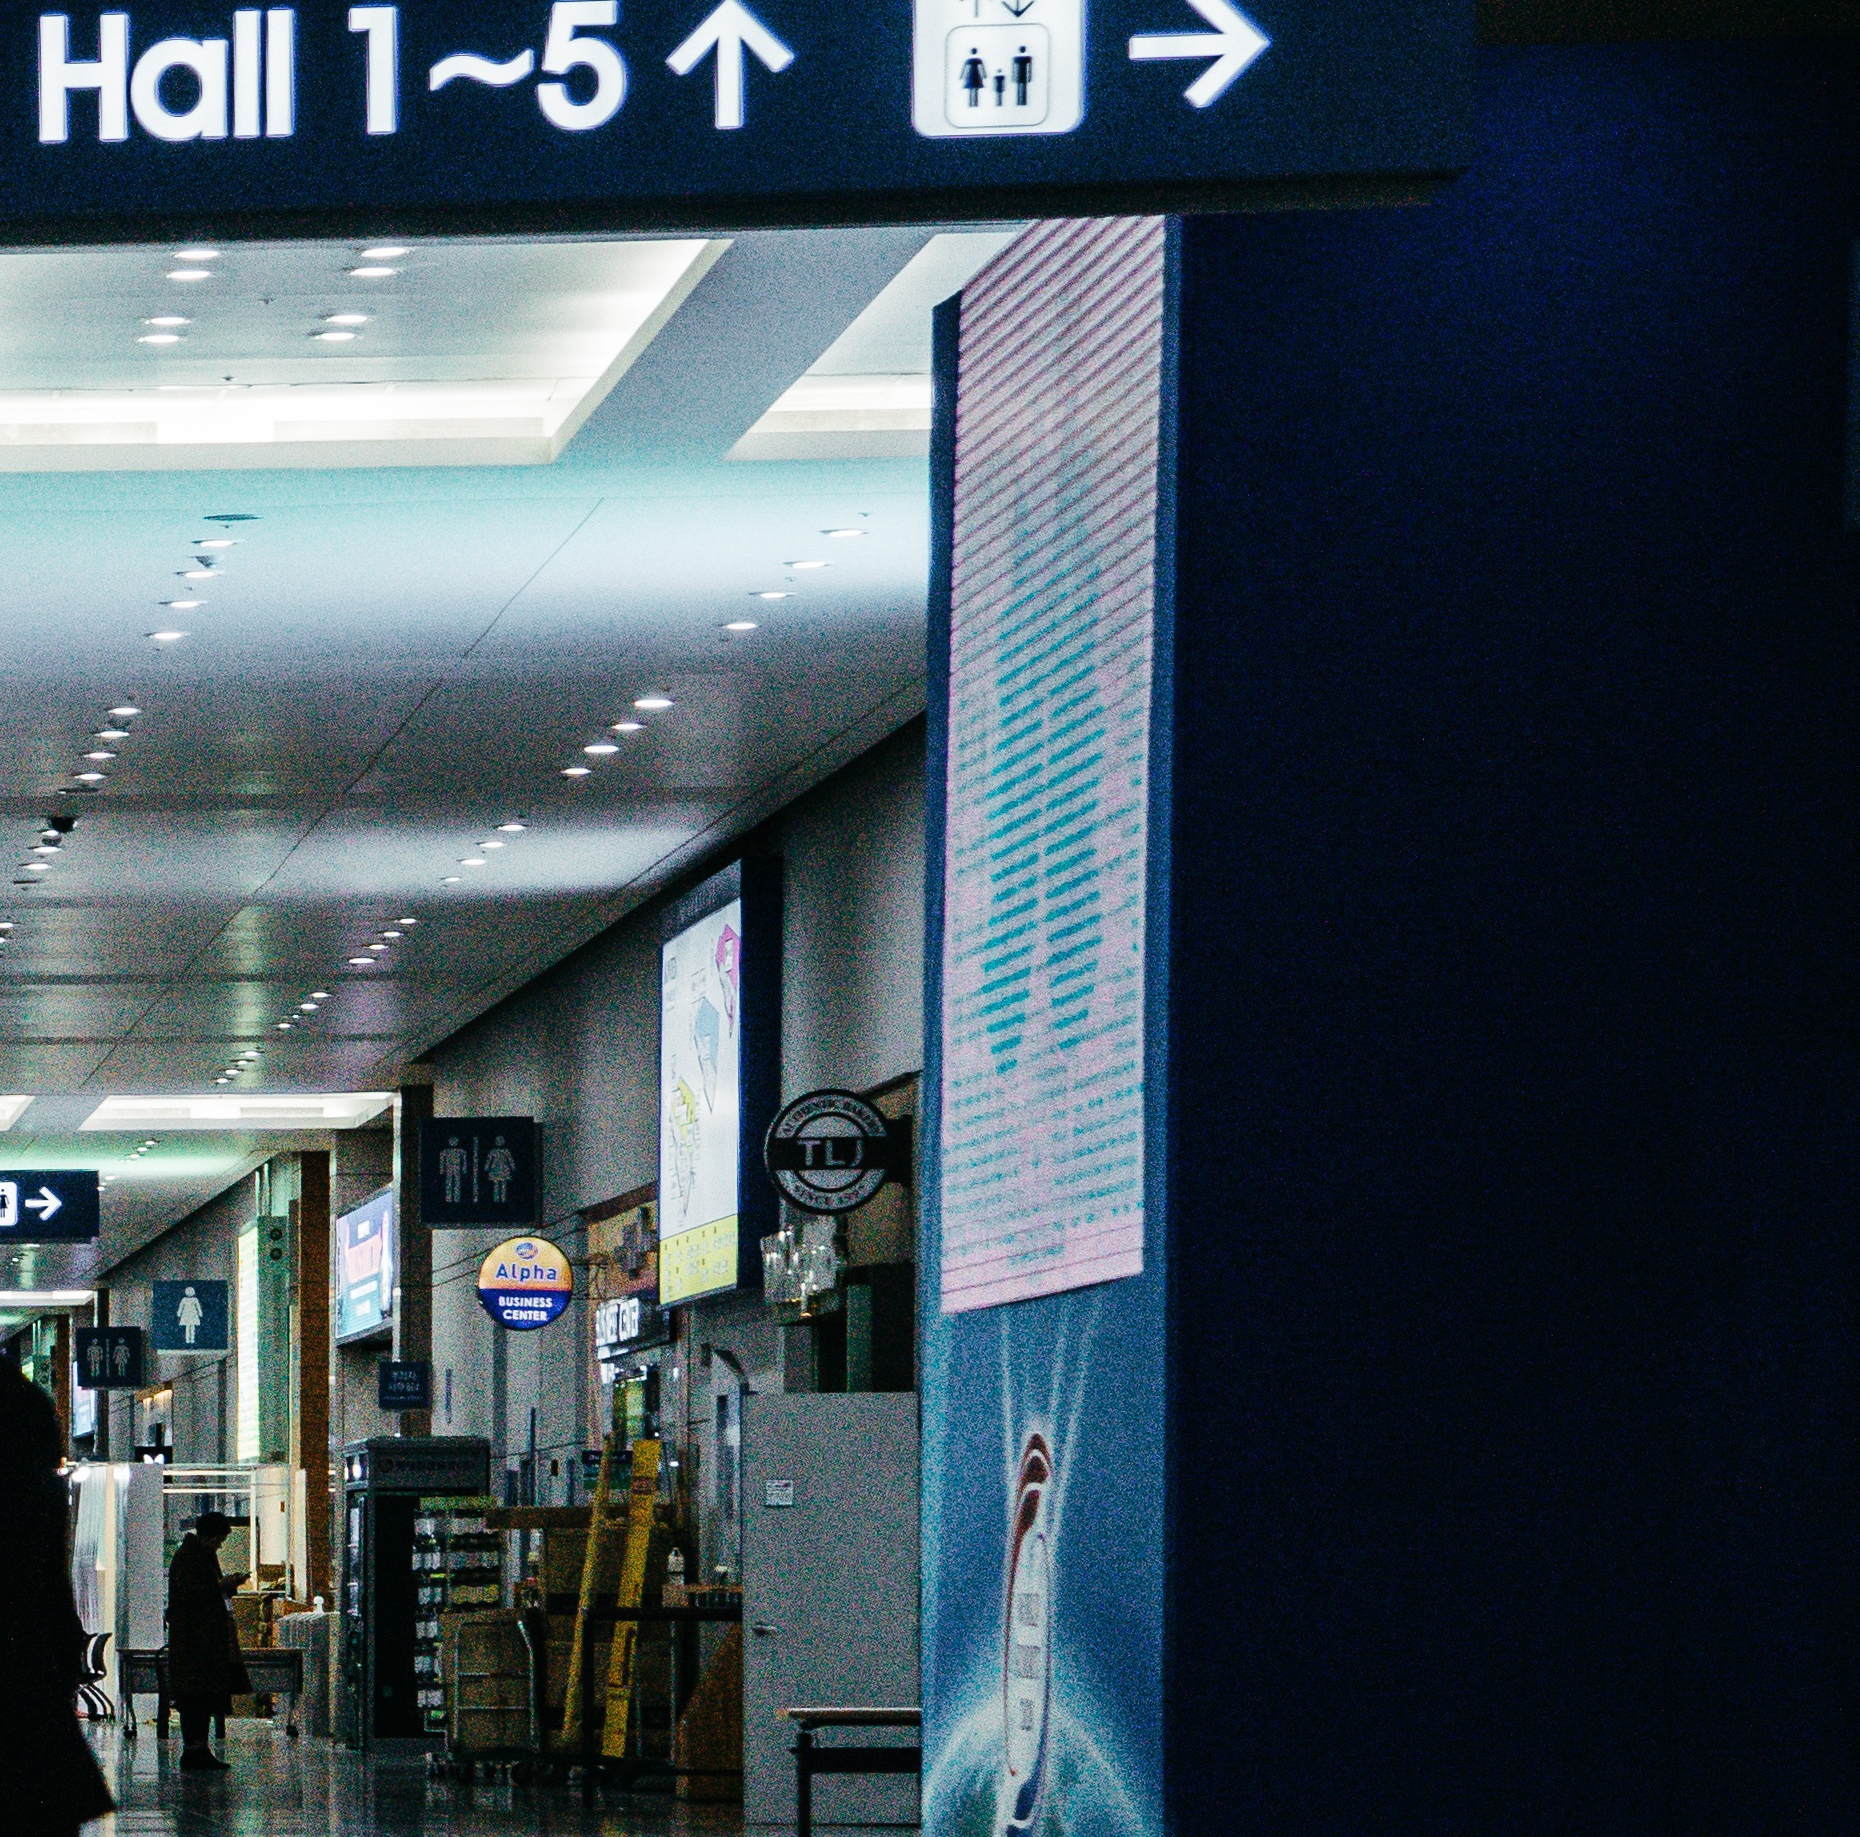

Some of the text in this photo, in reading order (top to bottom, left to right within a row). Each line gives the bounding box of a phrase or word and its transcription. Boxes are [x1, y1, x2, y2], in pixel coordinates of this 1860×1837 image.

[38, 0, 628, 142] Hall 1~5
[797, 1139, 863, 1167] TLJ
[495, 1263, 558, 1282] Alpha
[498, 1295, 553, 1308] BUSINESS
[502, 1309, 548, 1321] CENTER
